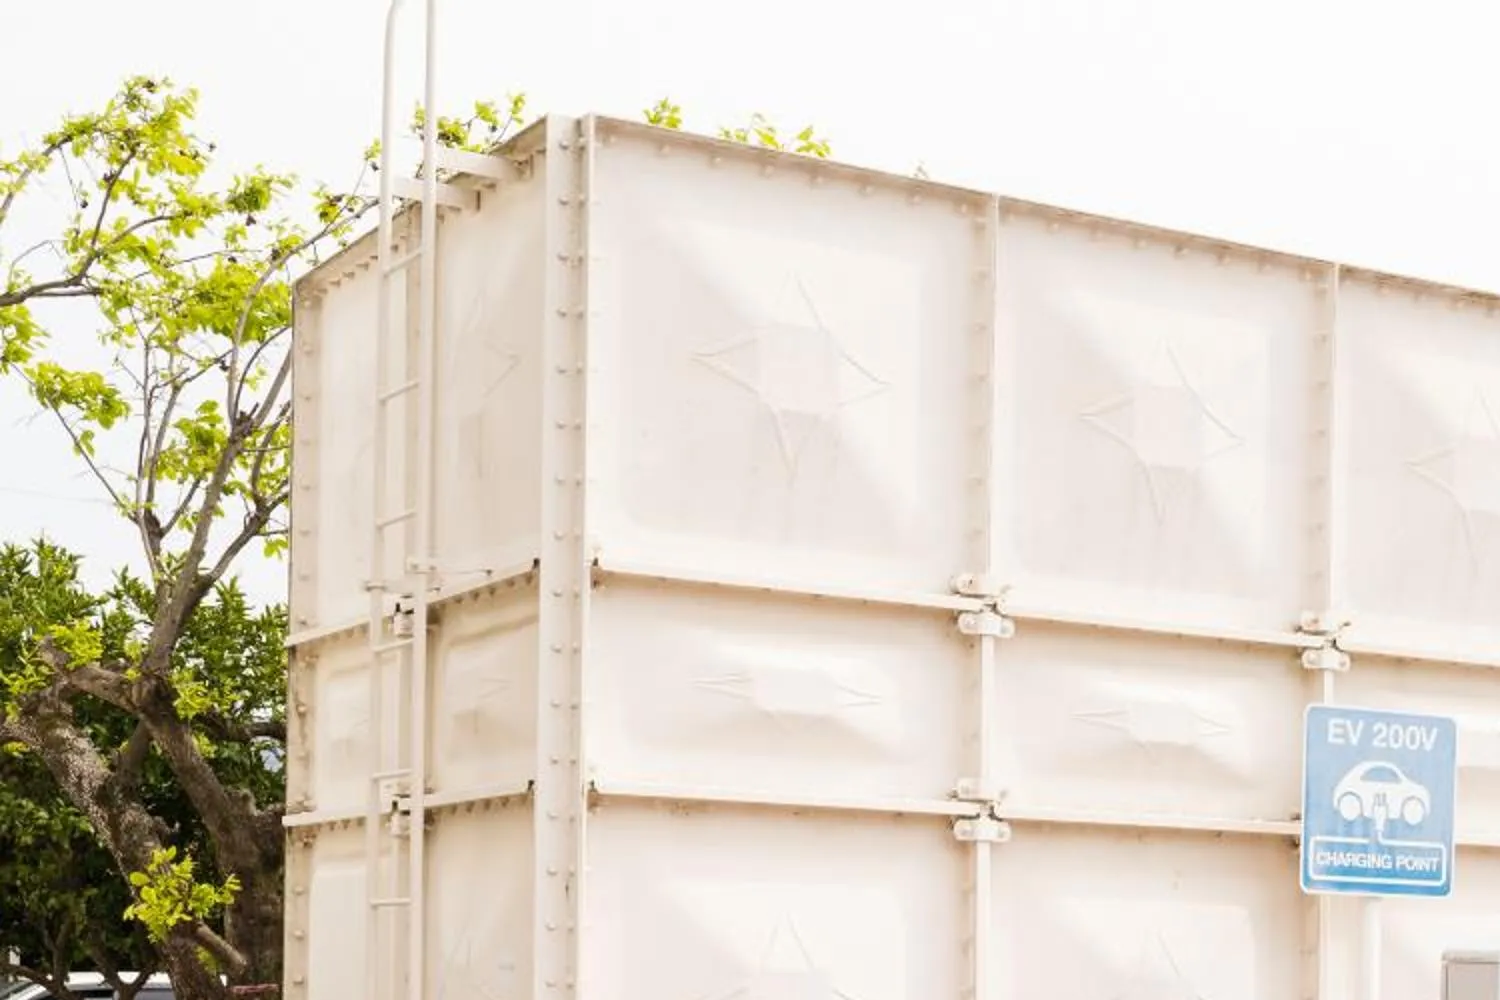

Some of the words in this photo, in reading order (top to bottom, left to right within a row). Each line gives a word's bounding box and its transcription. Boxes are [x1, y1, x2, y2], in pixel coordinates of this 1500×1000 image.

[1327, 718, 1364, 746] EV
[1372, 722, 1438, 751] 200V
[1316, 850, 1392, 869] CHARGING
[1395, 855, 1439, 872] POINT
